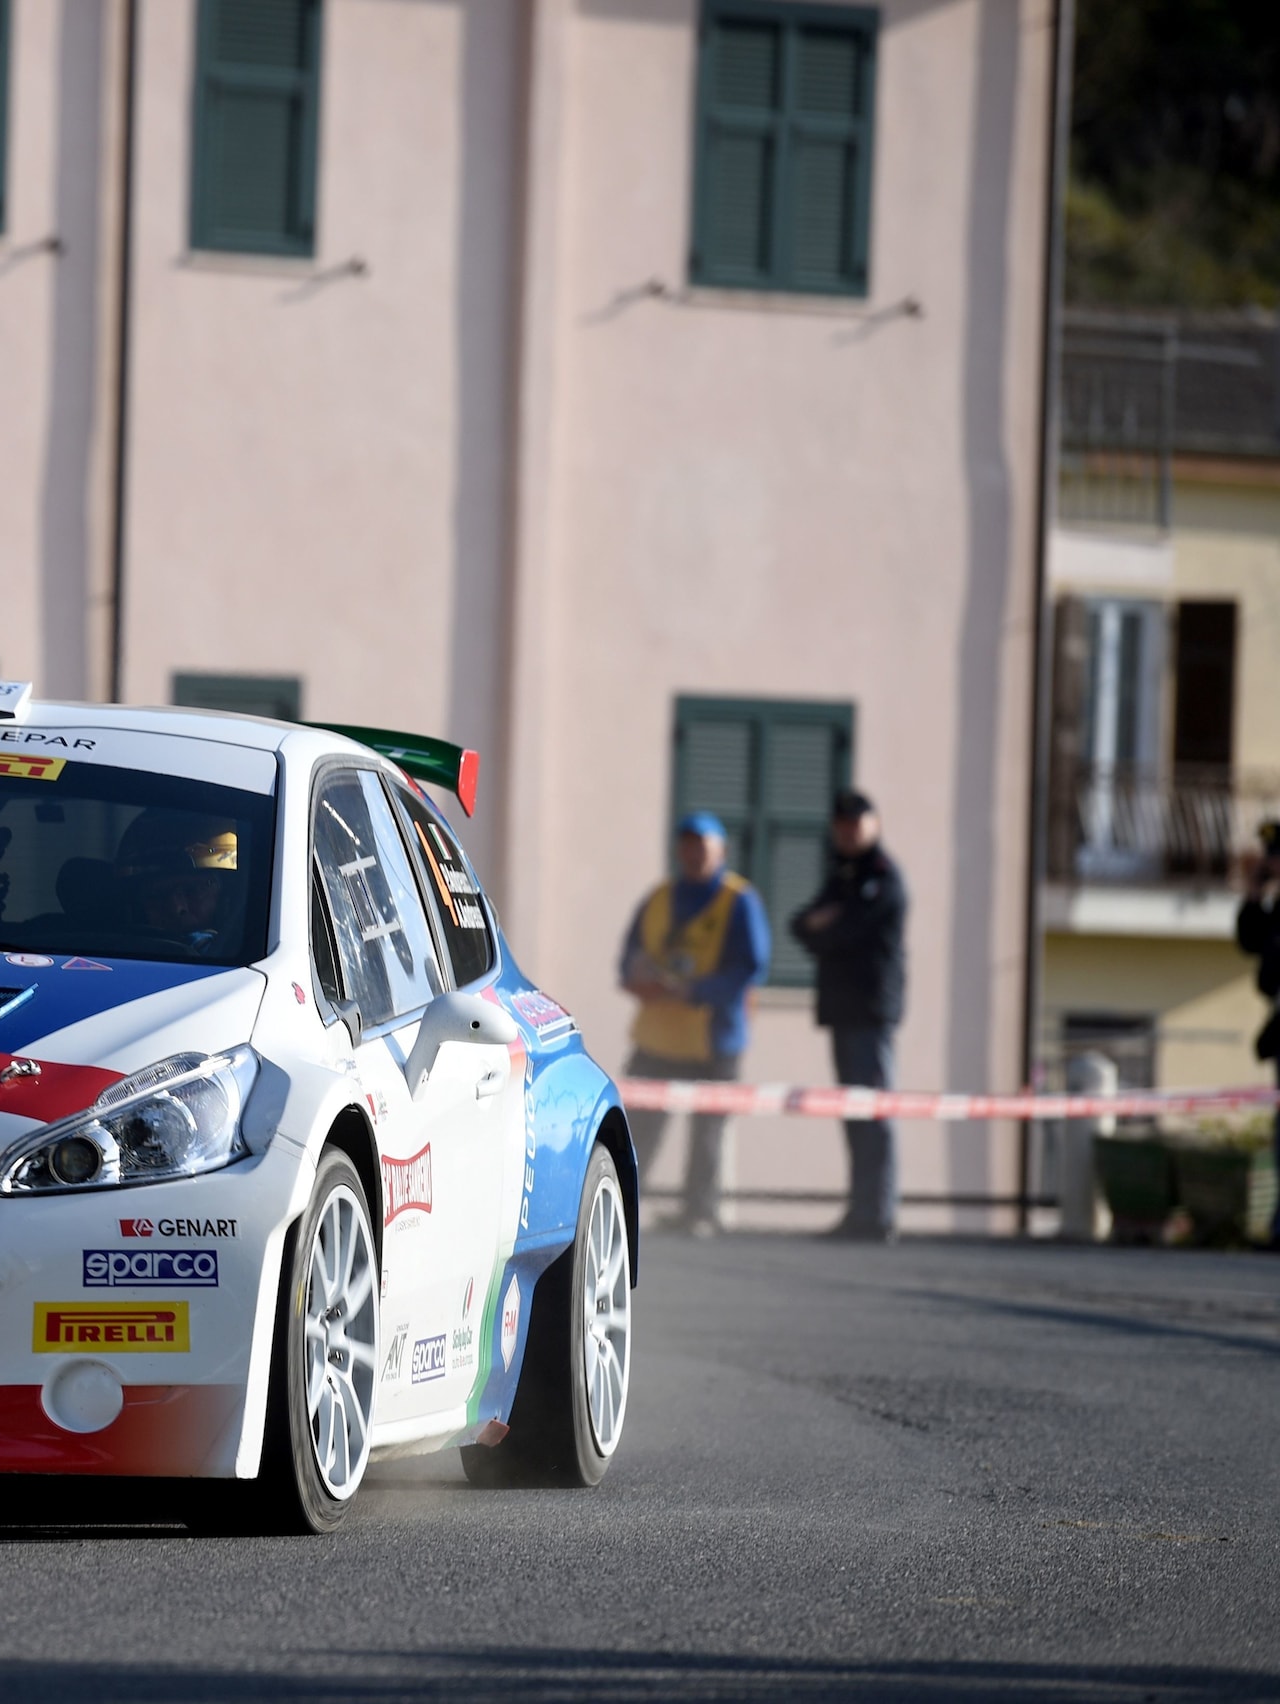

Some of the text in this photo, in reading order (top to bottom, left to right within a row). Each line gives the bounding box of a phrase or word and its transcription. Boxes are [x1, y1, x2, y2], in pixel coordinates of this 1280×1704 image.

[158, 1219, 238, 1238] GENART
[85, 1252, 217, 1287] sparco
[46, 1311, 177, 1342] PIRELLI
[412, 1337, 446, 1382] sparco
